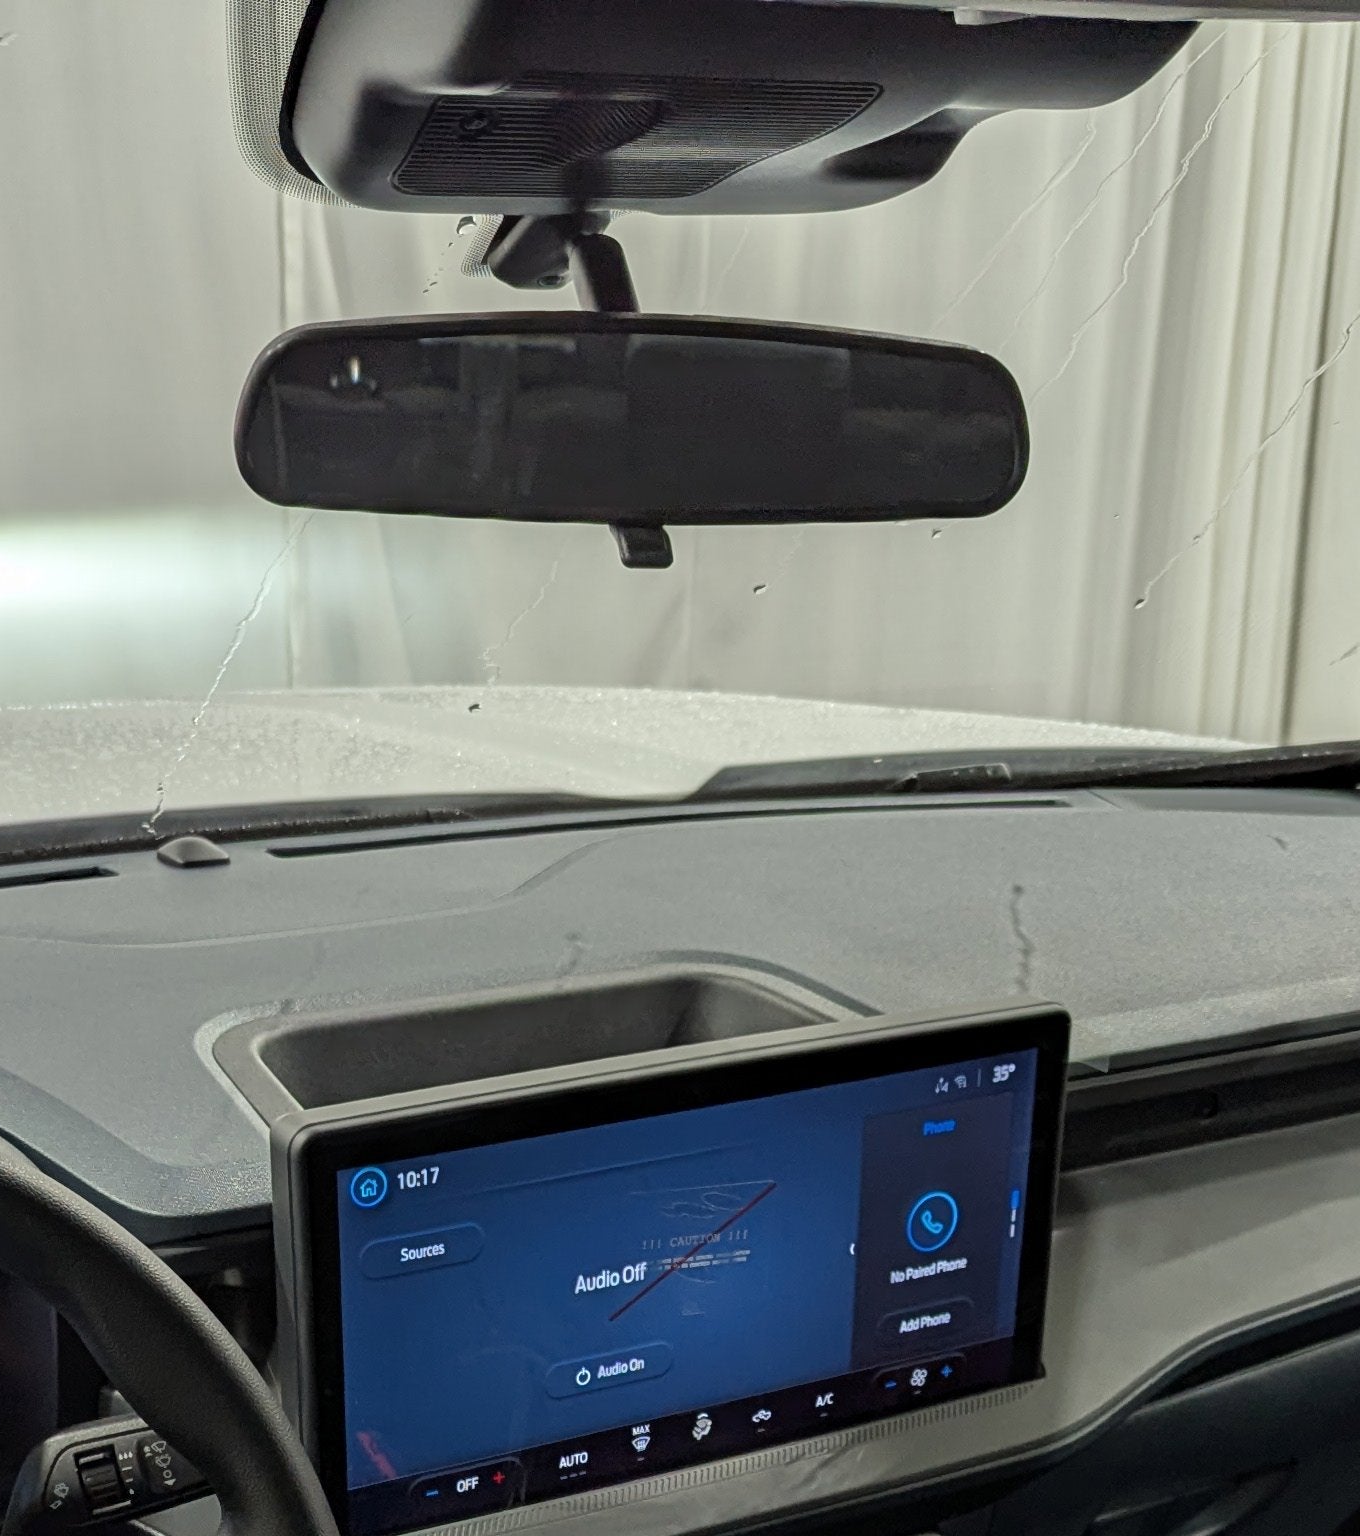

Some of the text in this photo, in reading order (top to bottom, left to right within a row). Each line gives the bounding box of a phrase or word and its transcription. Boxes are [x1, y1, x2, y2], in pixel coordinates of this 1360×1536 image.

[923, 1120, 957, 1136] Phone
[397, 1166, 440, 1190] 10:17
[400, 1243, 446, 1262] Sources
[574, 1261, 648, 1295] Audio Off
[890, 1257, 968, 1284] No Paired Phone
[899, 1312, 951, 1334] Add Phone
[597, 1358, 645, 1379] Audio On
[816, 1392, 834, 1408] A/C
[632, 1424, 651, 1436] MAX
[559, 1451, 588, 1469] AUTO
[456, 1476, 480, 1493] OFF
